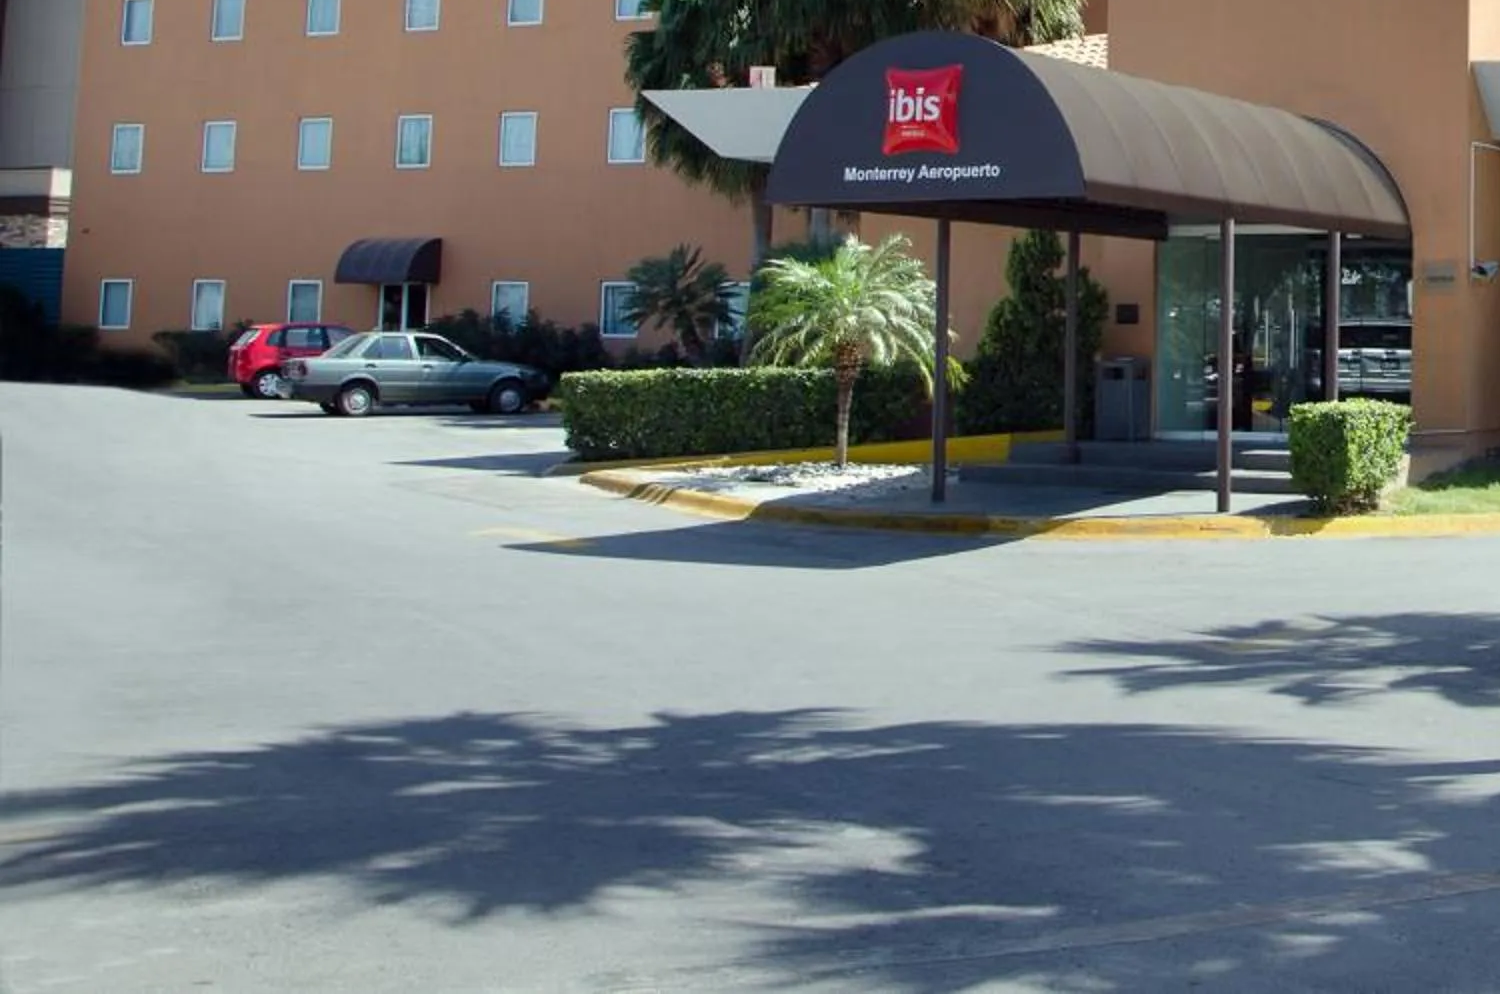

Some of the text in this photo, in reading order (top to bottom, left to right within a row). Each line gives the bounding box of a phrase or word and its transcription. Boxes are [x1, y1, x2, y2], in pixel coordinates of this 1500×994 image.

[889, 87, 940, 123] ibis
[844, 163, 1000, 183] Monterrey Aeropuerto
